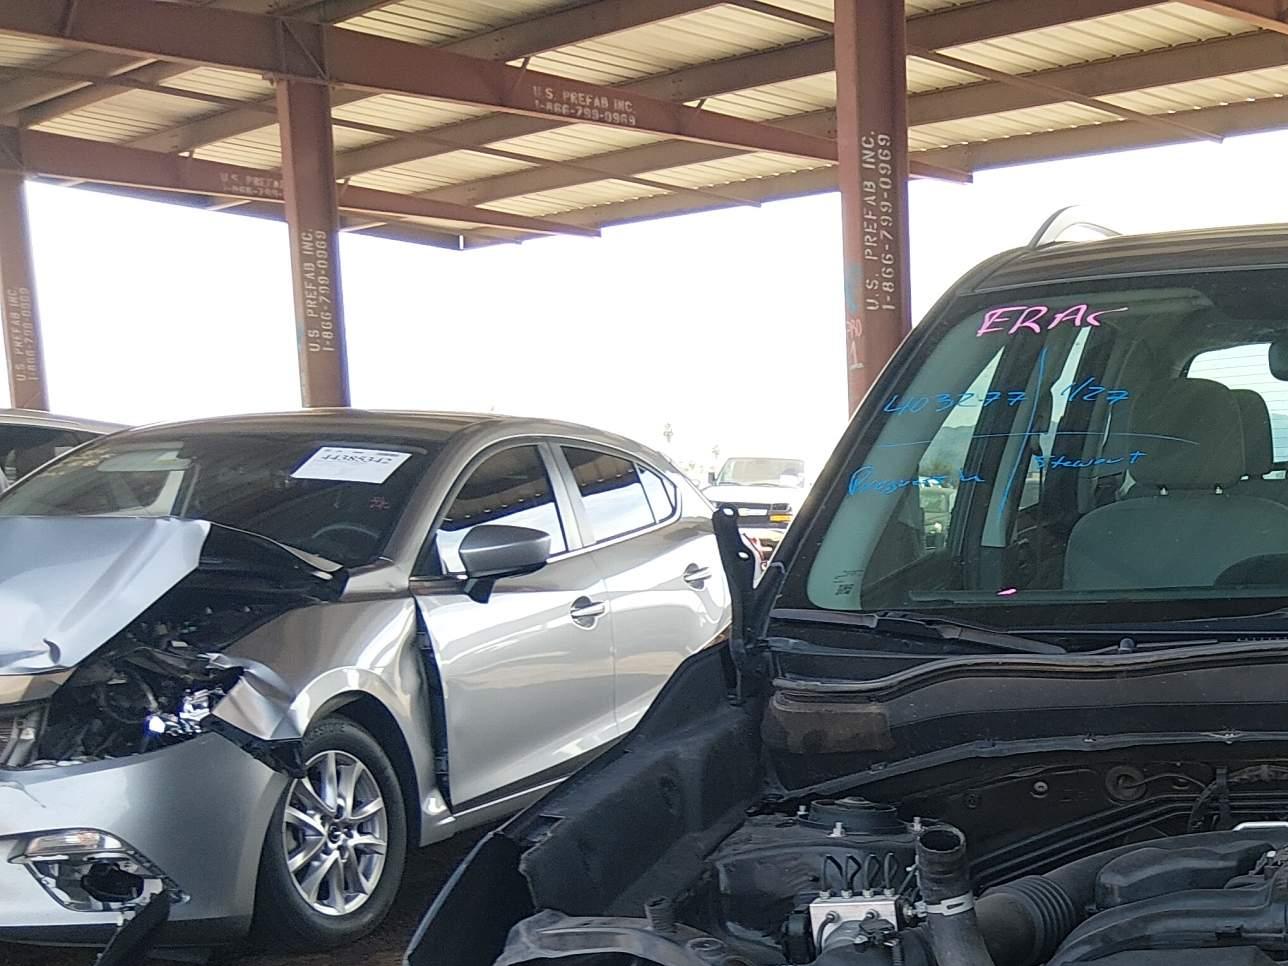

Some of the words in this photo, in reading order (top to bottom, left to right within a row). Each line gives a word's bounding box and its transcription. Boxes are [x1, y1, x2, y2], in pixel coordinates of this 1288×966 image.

[562, 89, 609, 109] PREFAB
[862, 131, 877, 170] INC.
[863, 180, 879, 261] PREFAB
[877, 134, 896, 311] 1-866-799-0969
[304, 261, 320, 318] PREFAB
[865, 272, 880, 311] U.S.
